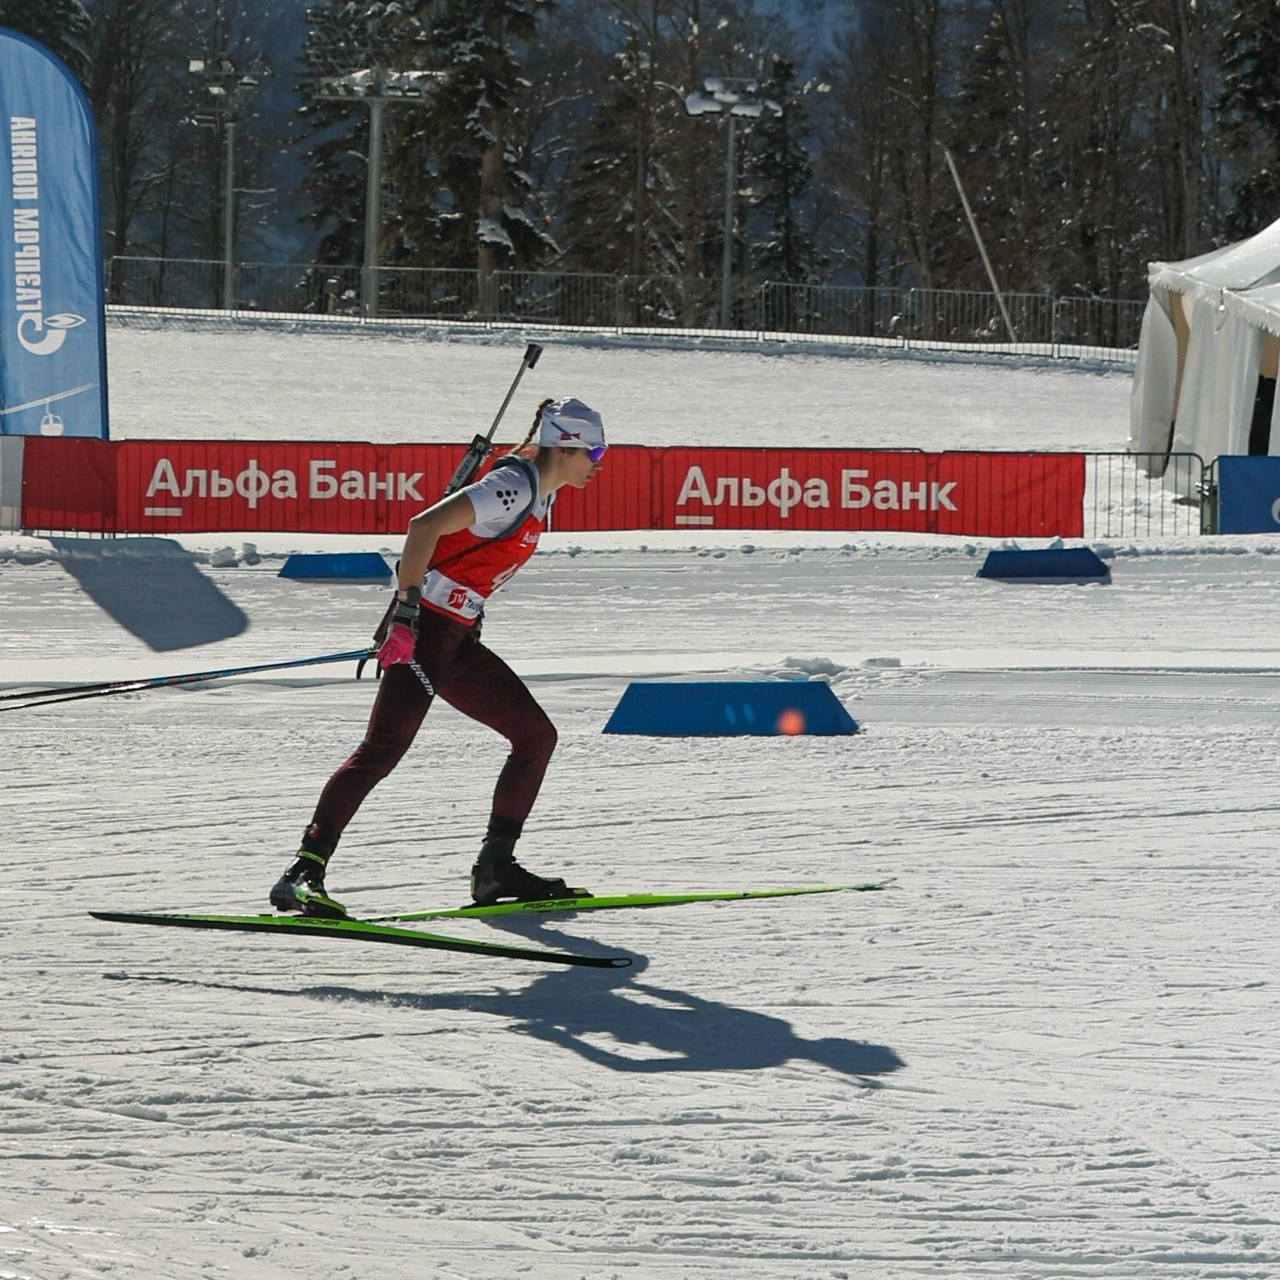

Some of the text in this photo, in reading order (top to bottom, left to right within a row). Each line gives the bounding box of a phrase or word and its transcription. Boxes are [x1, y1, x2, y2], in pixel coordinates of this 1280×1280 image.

[146, 459, 425, 508] Альфа Банк
[676, 465, 958, 518] Альфа Банк
